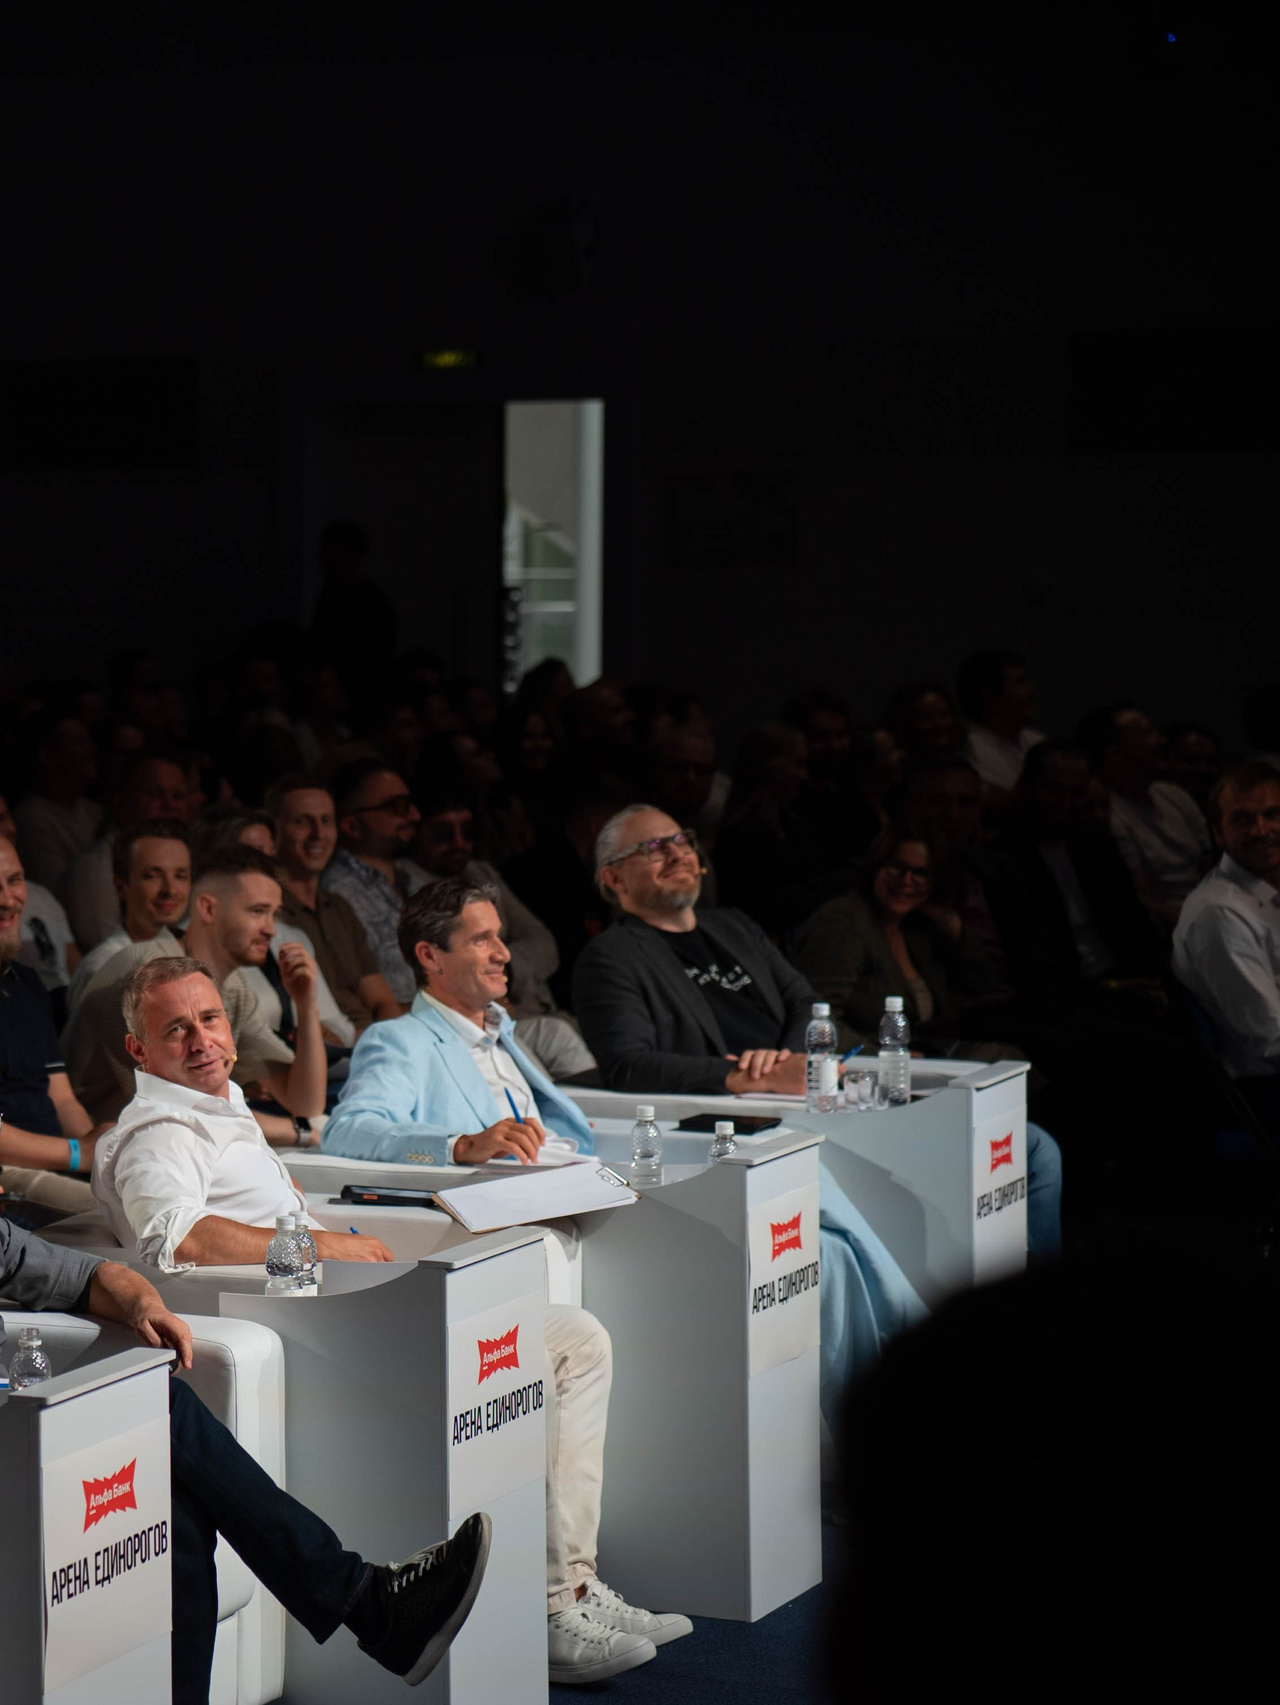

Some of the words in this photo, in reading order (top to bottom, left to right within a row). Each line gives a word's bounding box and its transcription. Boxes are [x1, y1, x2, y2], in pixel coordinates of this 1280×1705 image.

[752, 1281, 776, 1314] АРЕНА
[778, 1261, 819, 1305] ЕДИНОРОГОВ
[453, 1406, 483, 1446] АРЕНА
[486, 1380, 544, 1433] ЕДИНОРОГОВ
[89, 1487, 113, 1509] Альфа
[113, 1481, 131, 1497] Банк
[51, 1557, 90, 1607] АРЕНА
[94, 1520, 168, 1588] ЕДИНОРОГОВ
